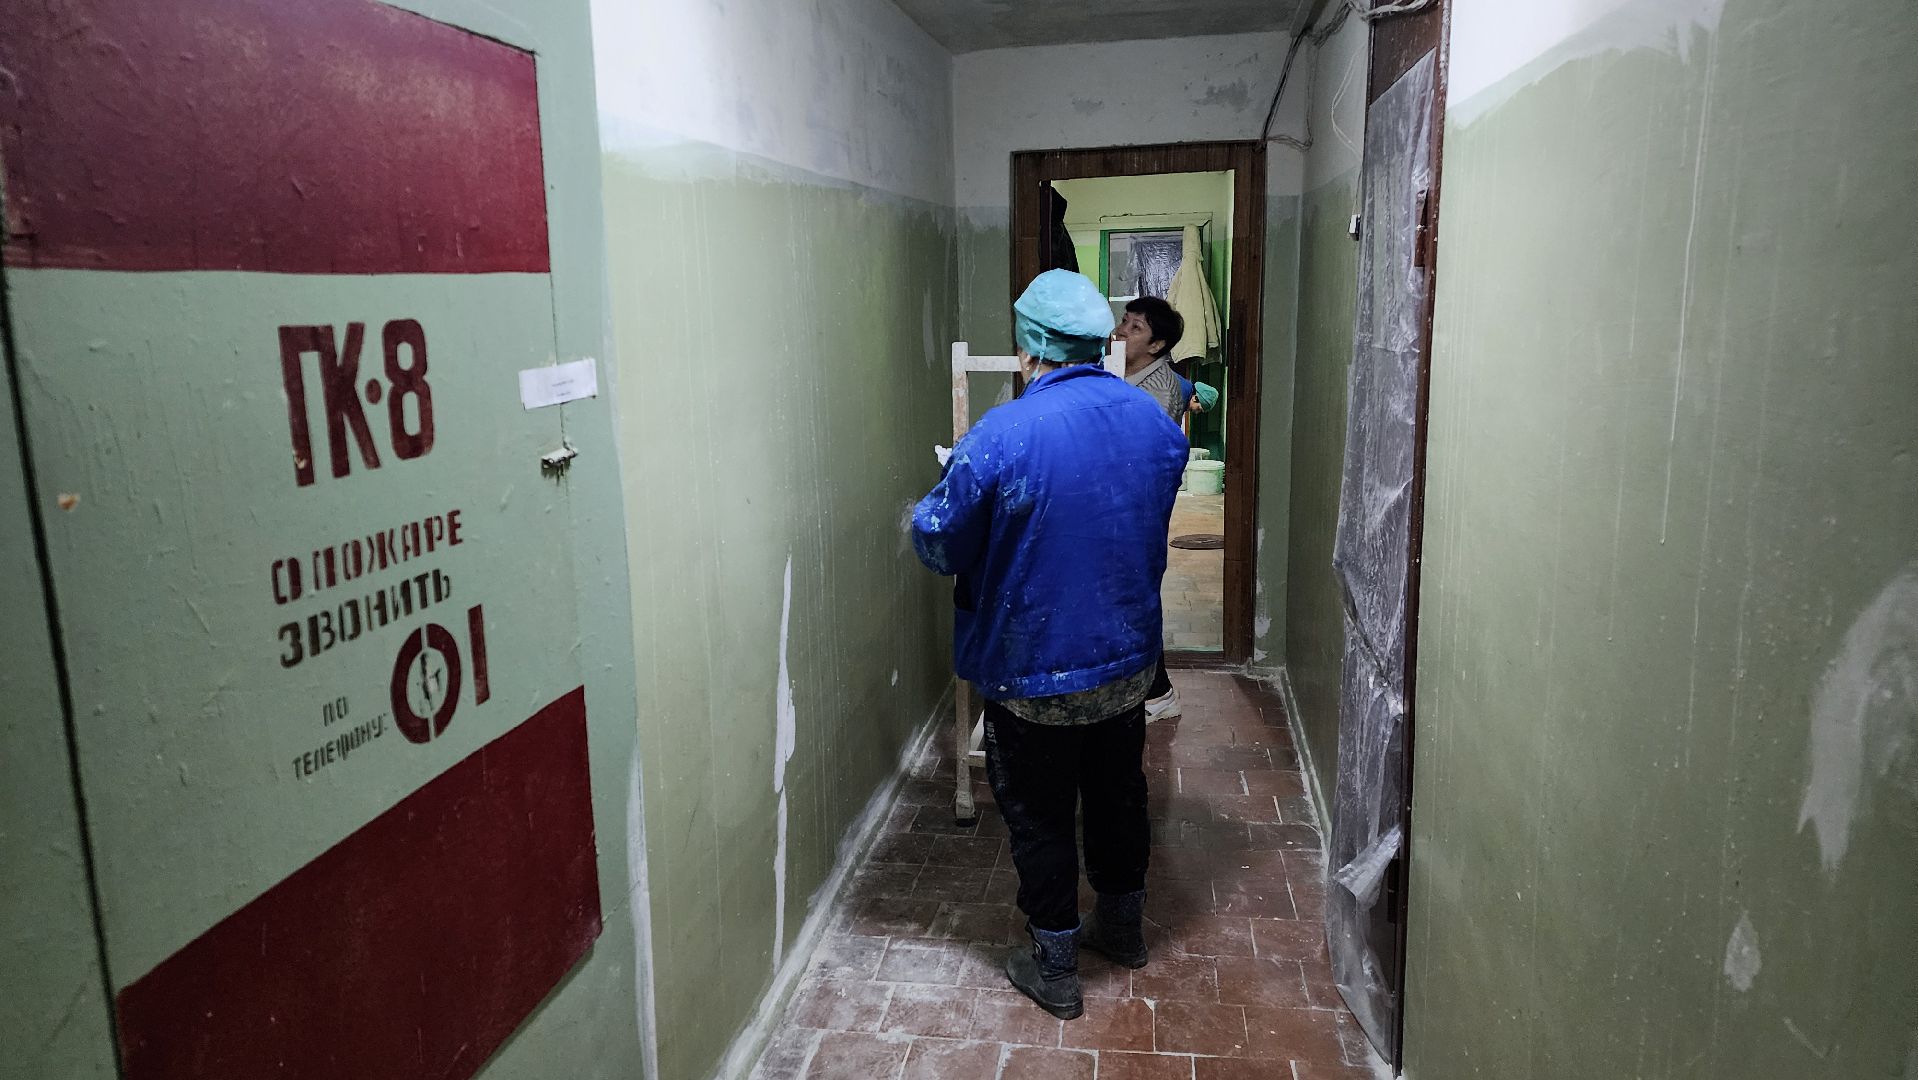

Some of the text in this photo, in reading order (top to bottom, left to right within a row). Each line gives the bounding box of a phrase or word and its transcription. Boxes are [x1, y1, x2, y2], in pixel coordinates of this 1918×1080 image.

[271, 509, 464, 605] О ПОЖАРЕ
[277, 568, 451, 669] ЗВОНИТЬ
[322, 696, 349, 727] ПО
[390, 603, 490, 744] 01
